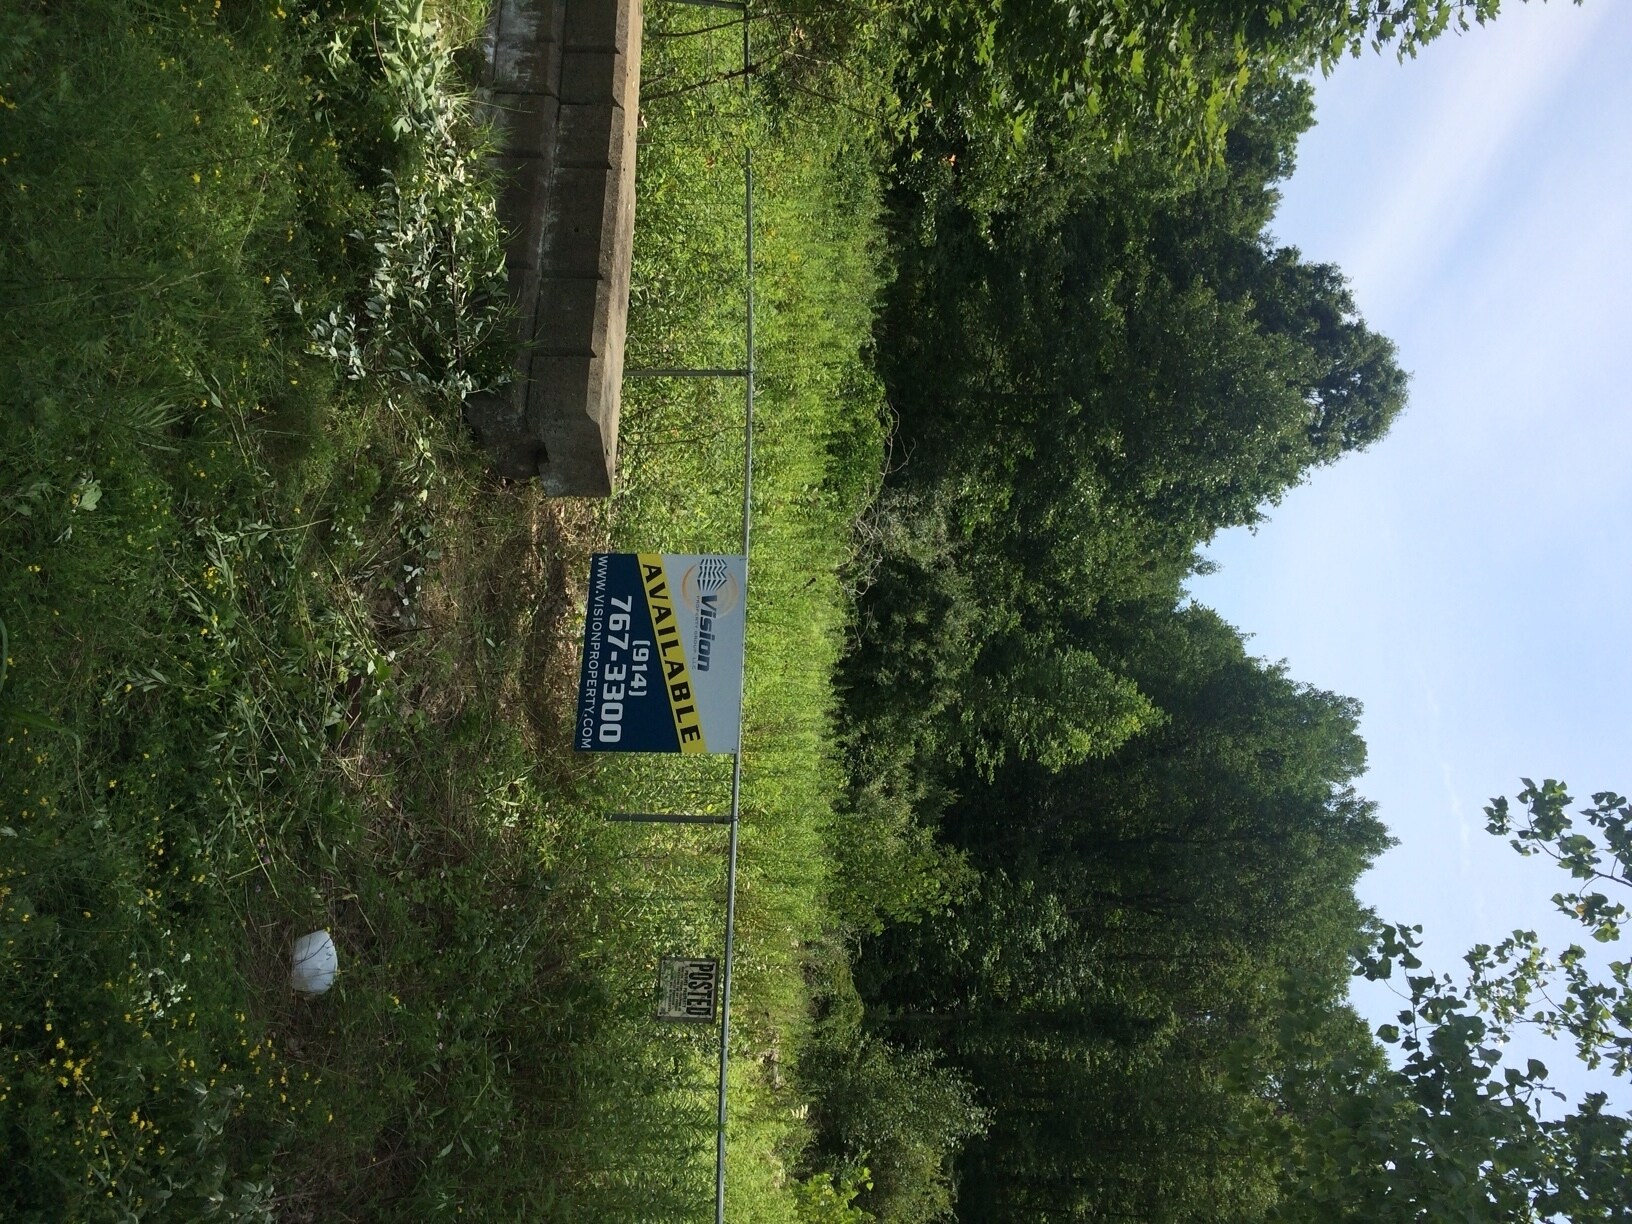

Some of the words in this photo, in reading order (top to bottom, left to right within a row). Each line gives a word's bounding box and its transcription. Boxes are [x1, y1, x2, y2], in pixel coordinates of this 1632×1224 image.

[581, 555, 608, 749] WWW.VISIONPROPERTY.COM
[599, 595, 632, 743] 767-3300
[628, 640, 650, 697] (914)
[642, 563, 701, 744] AVAILABLE
[697, 594, 717, 672] Vision
[686, 963, 714, 1016] POSTED
